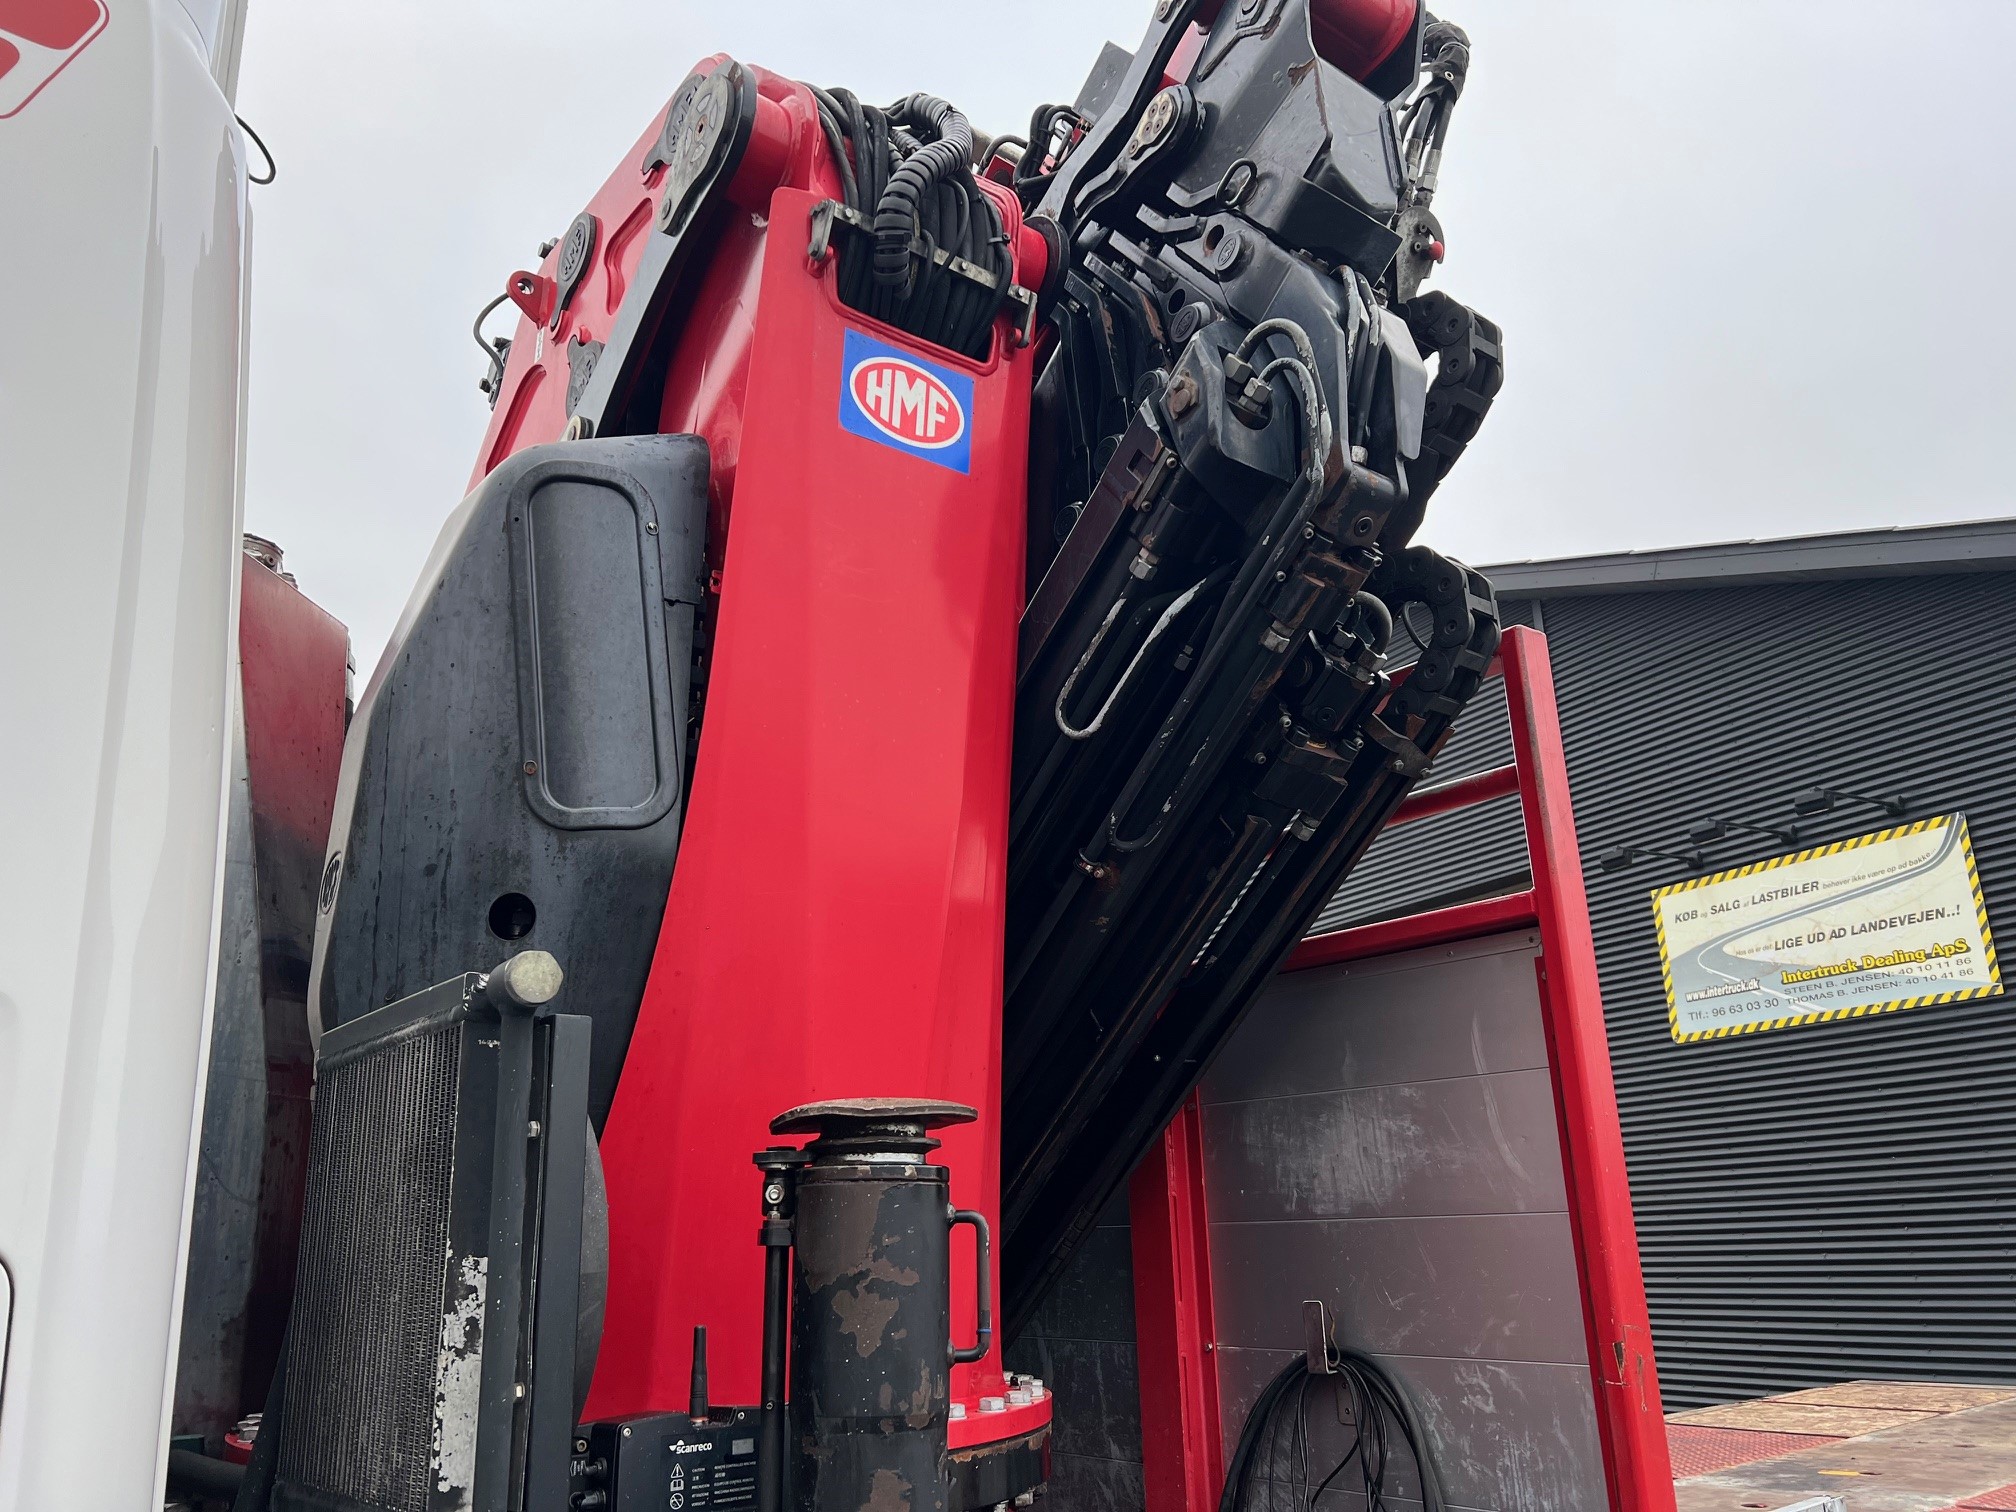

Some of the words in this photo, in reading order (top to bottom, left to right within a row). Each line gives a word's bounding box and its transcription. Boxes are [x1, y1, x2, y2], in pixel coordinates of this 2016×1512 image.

[865, 368, 949, 438] HMF
[1674, 910, 1698, 923] KØB
[1710, 899, 1740, 915] SALG
[1751, 881, 1819, 905] LASTBILER
[1851, 873, 1866, 883] ikke
[1887, 866, 1896, 874] op
[1898, 861, 1907, 870] ad
[1774, 936, 1803, 951] LIGE
[1807, 932, 1826, 945] UD
[1829, 927, 1847, 940] AD
[1851, 904, 1961, 936] LANDEVEJEN..!
[1781, 958, 1859, 984] Intertruck
[1861, 949, 1927, 970] Dealing
[1931, 937, 1969, 958] ApS
[1784, 982, 1822, 995] STEEN
[1826, 980, 1838, 988] B.
[1841, 971, 1895, 986] JENSEN:
[1898, 967, 1914, 975] 40
[1917, 964, 1932, 972] 10
[1937, 961, 1950, 969] 11
[1956, 957, 1972, 966] 86
[1685, 977, 1760, 1002] www.intertruck.dk
[1786, 991, 1834, 1005] THOMAS
[1837, 989, 1848, 997] B.
[1851, 981, 1902, 994] JENSEN:
[1906, 977, 1920, 985] 40
[1923, 974, 1938, 982] 10
[1941, 971, 1954, 979] 41
[1959, 968, 1974, 976] 86
[1688, 1011, 1709, 1021] Tlf.:
[1712, 1007, 1726, 1017] 96
[1729, 1004, 1743, 1014] 63
[1746, 1001, 1761, 1011] 03
[1764, 998, 1779, 1008] 30
[676, 1442, 713, 1454] scanreco
